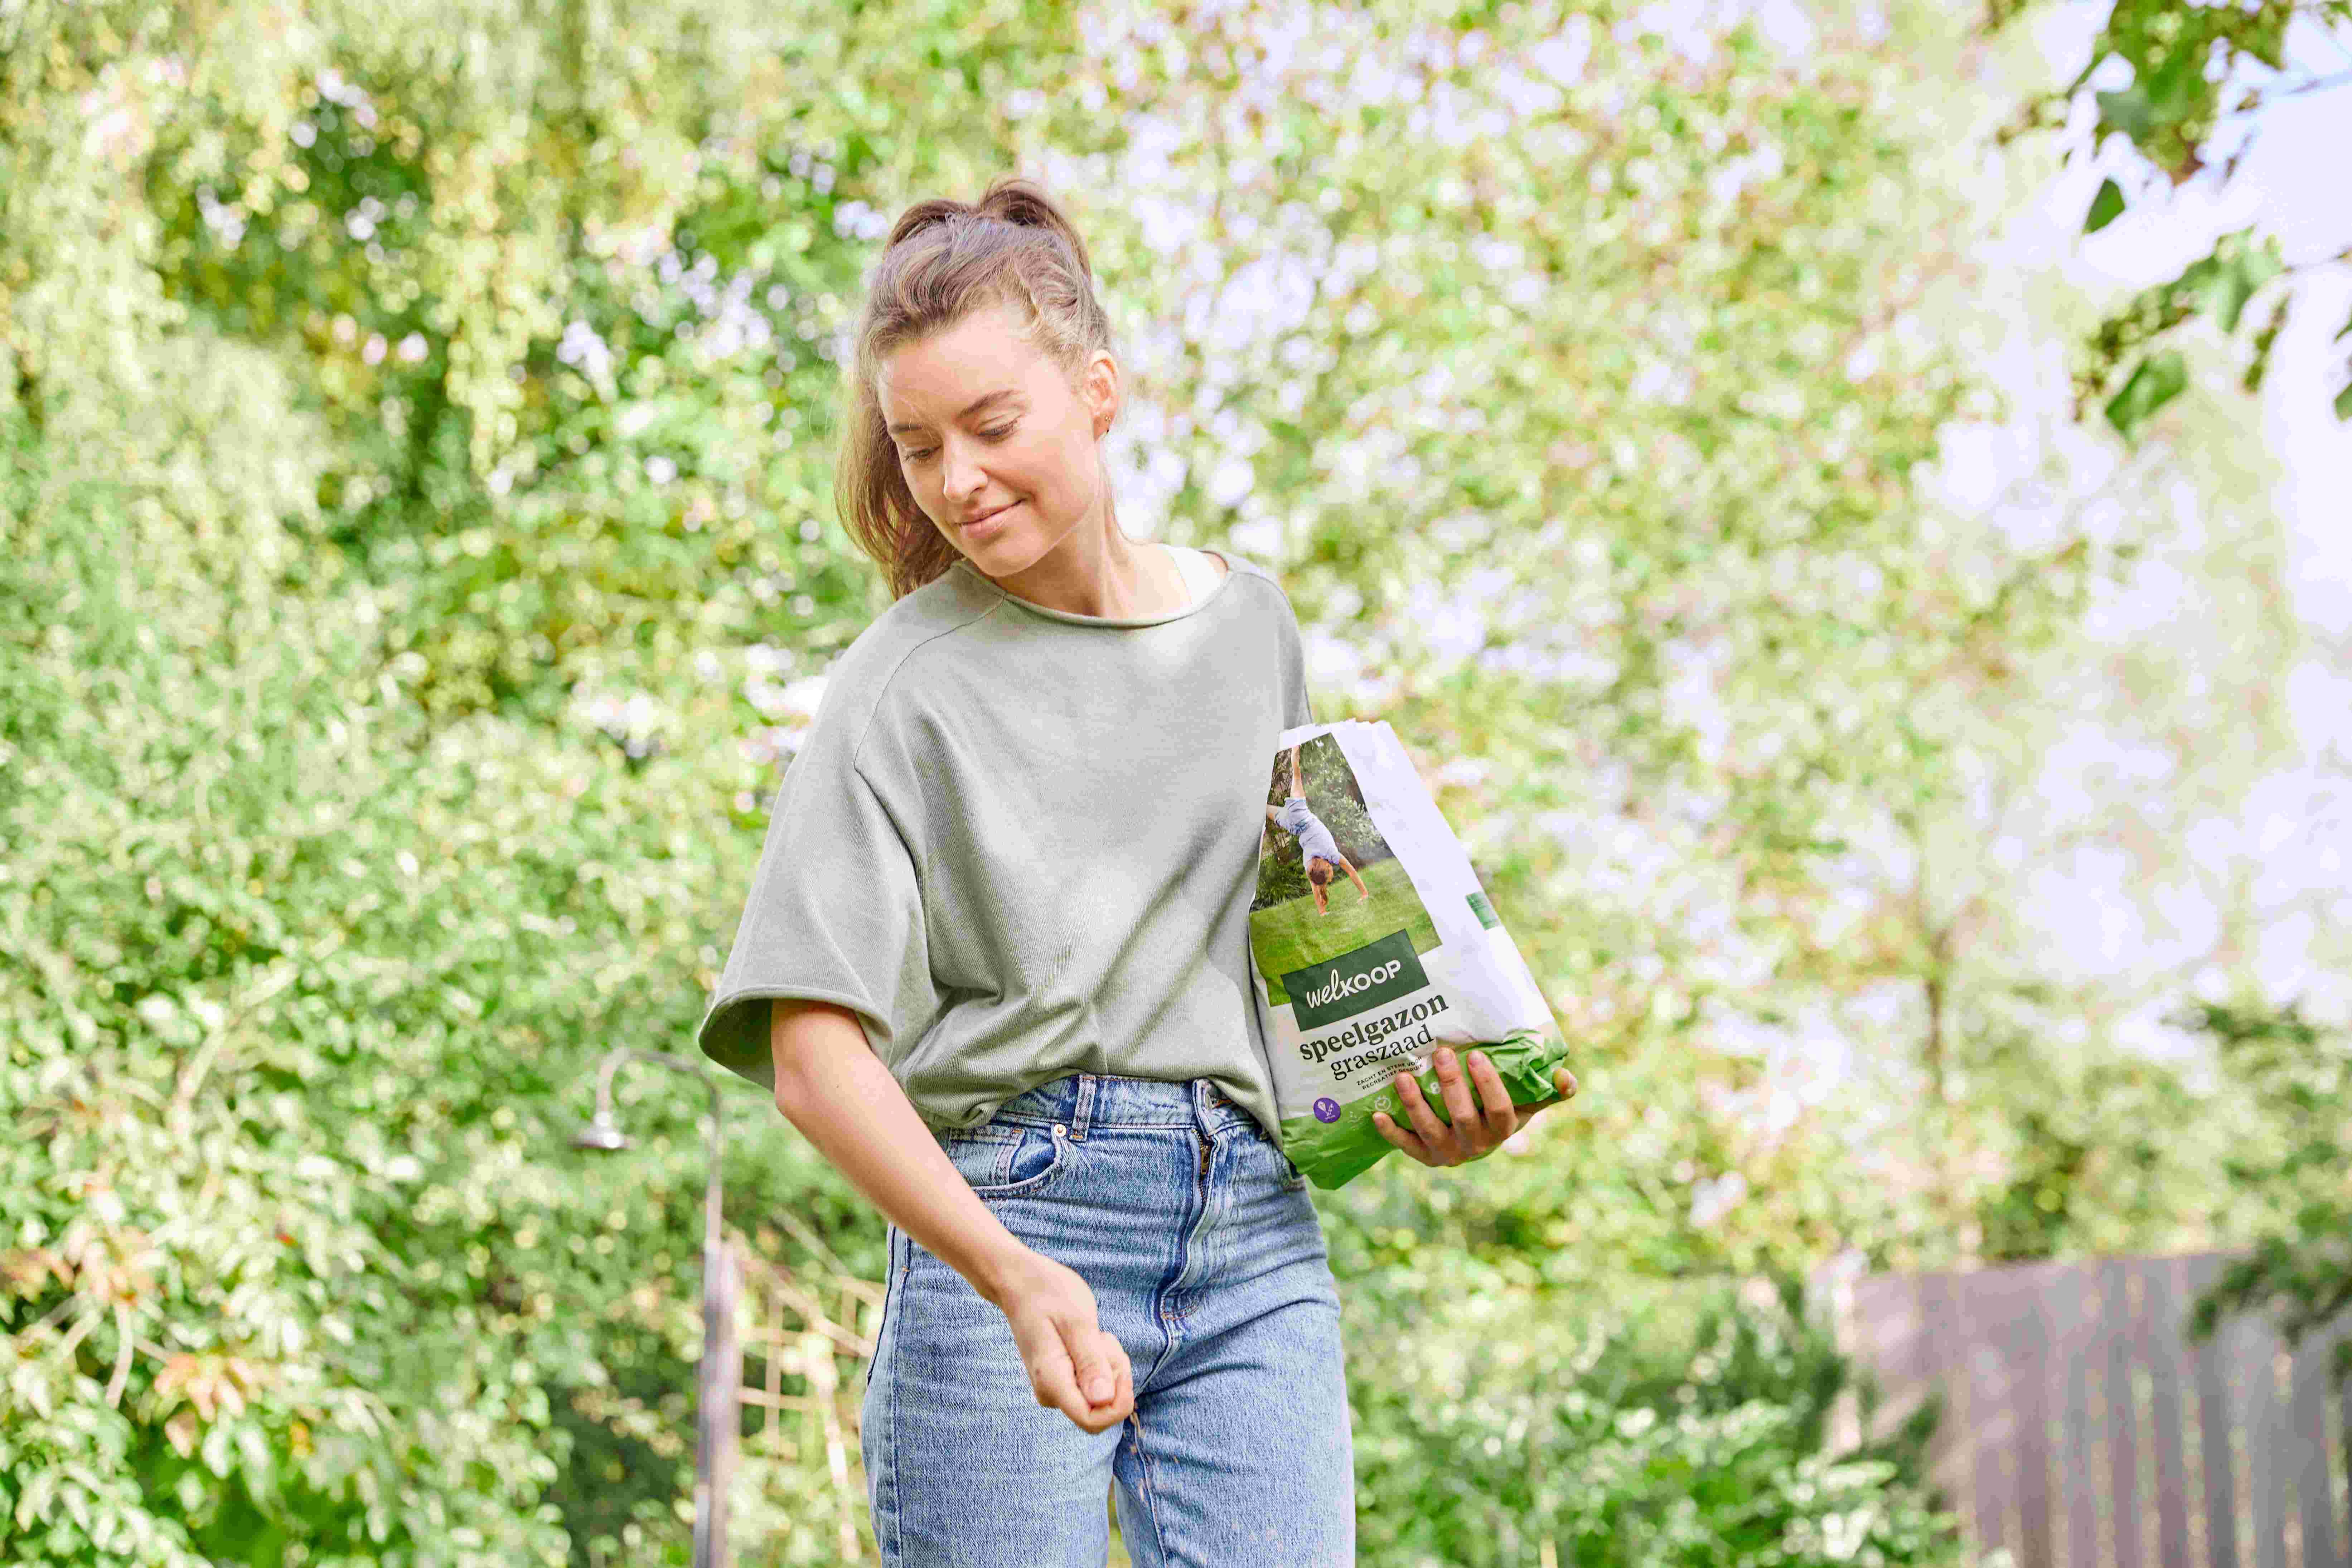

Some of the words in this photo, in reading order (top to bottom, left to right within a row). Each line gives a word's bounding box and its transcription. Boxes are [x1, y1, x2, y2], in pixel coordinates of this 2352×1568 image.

[1300, 994, 1449, 1063] speelgazon
[1331, 1024, 1434, 1081] graszaad
[1356, 1074, 1376, 1085] ZACHT
[1362, 1070, 1396, 1090] RECREATIEF
